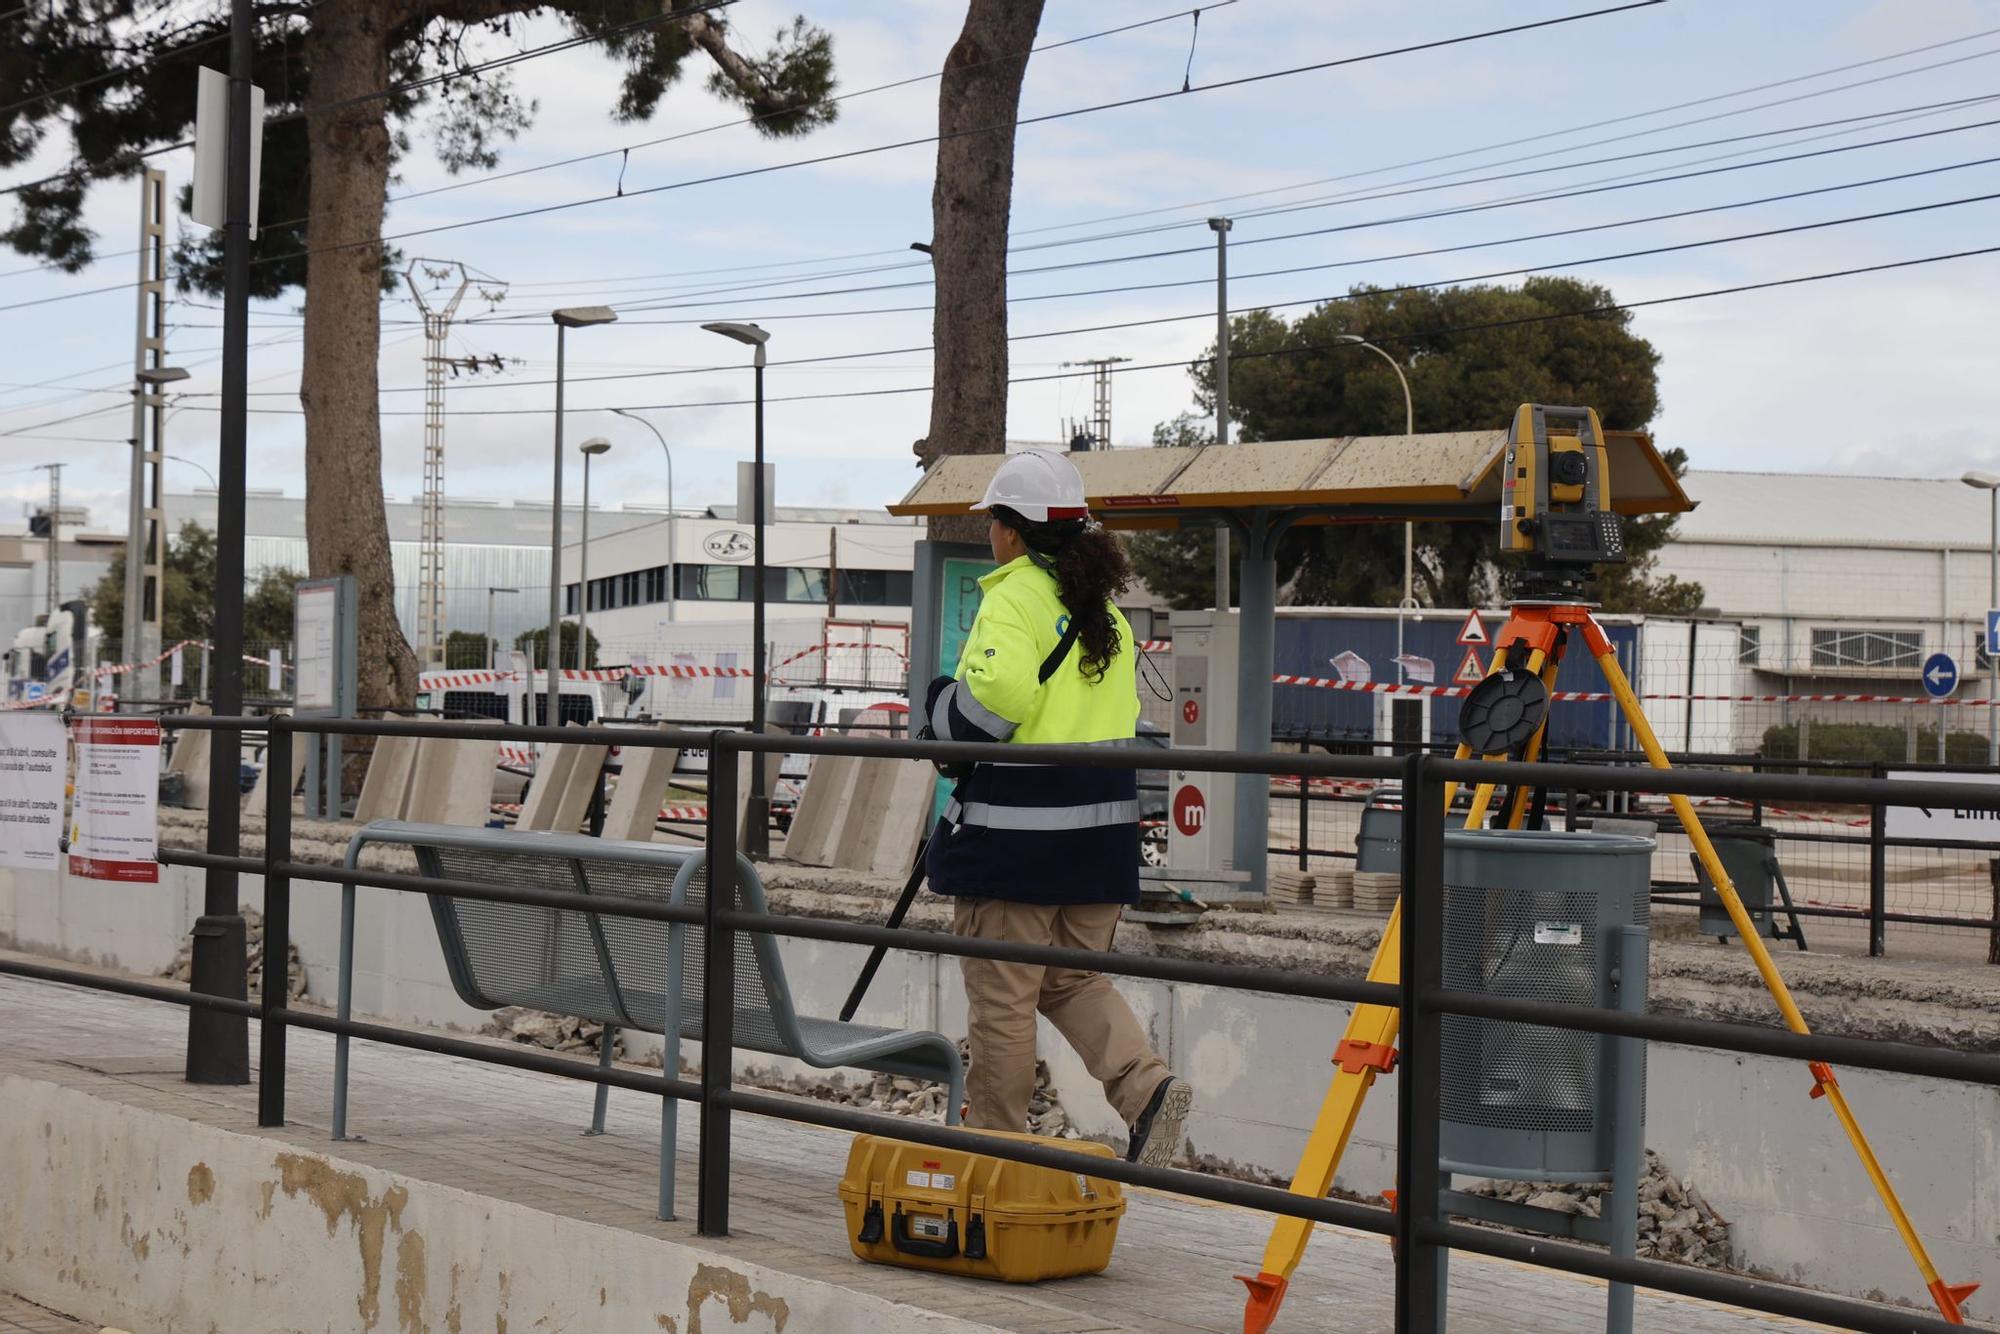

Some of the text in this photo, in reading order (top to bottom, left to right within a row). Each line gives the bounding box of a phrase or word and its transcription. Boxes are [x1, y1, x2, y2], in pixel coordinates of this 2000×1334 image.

[124, 727, 159, 736] IMPORTANTE
[31, 748, 57, 758] consulte
[32, 801, 58, 810] consulte
[1184, 804, 1204, 826] m
